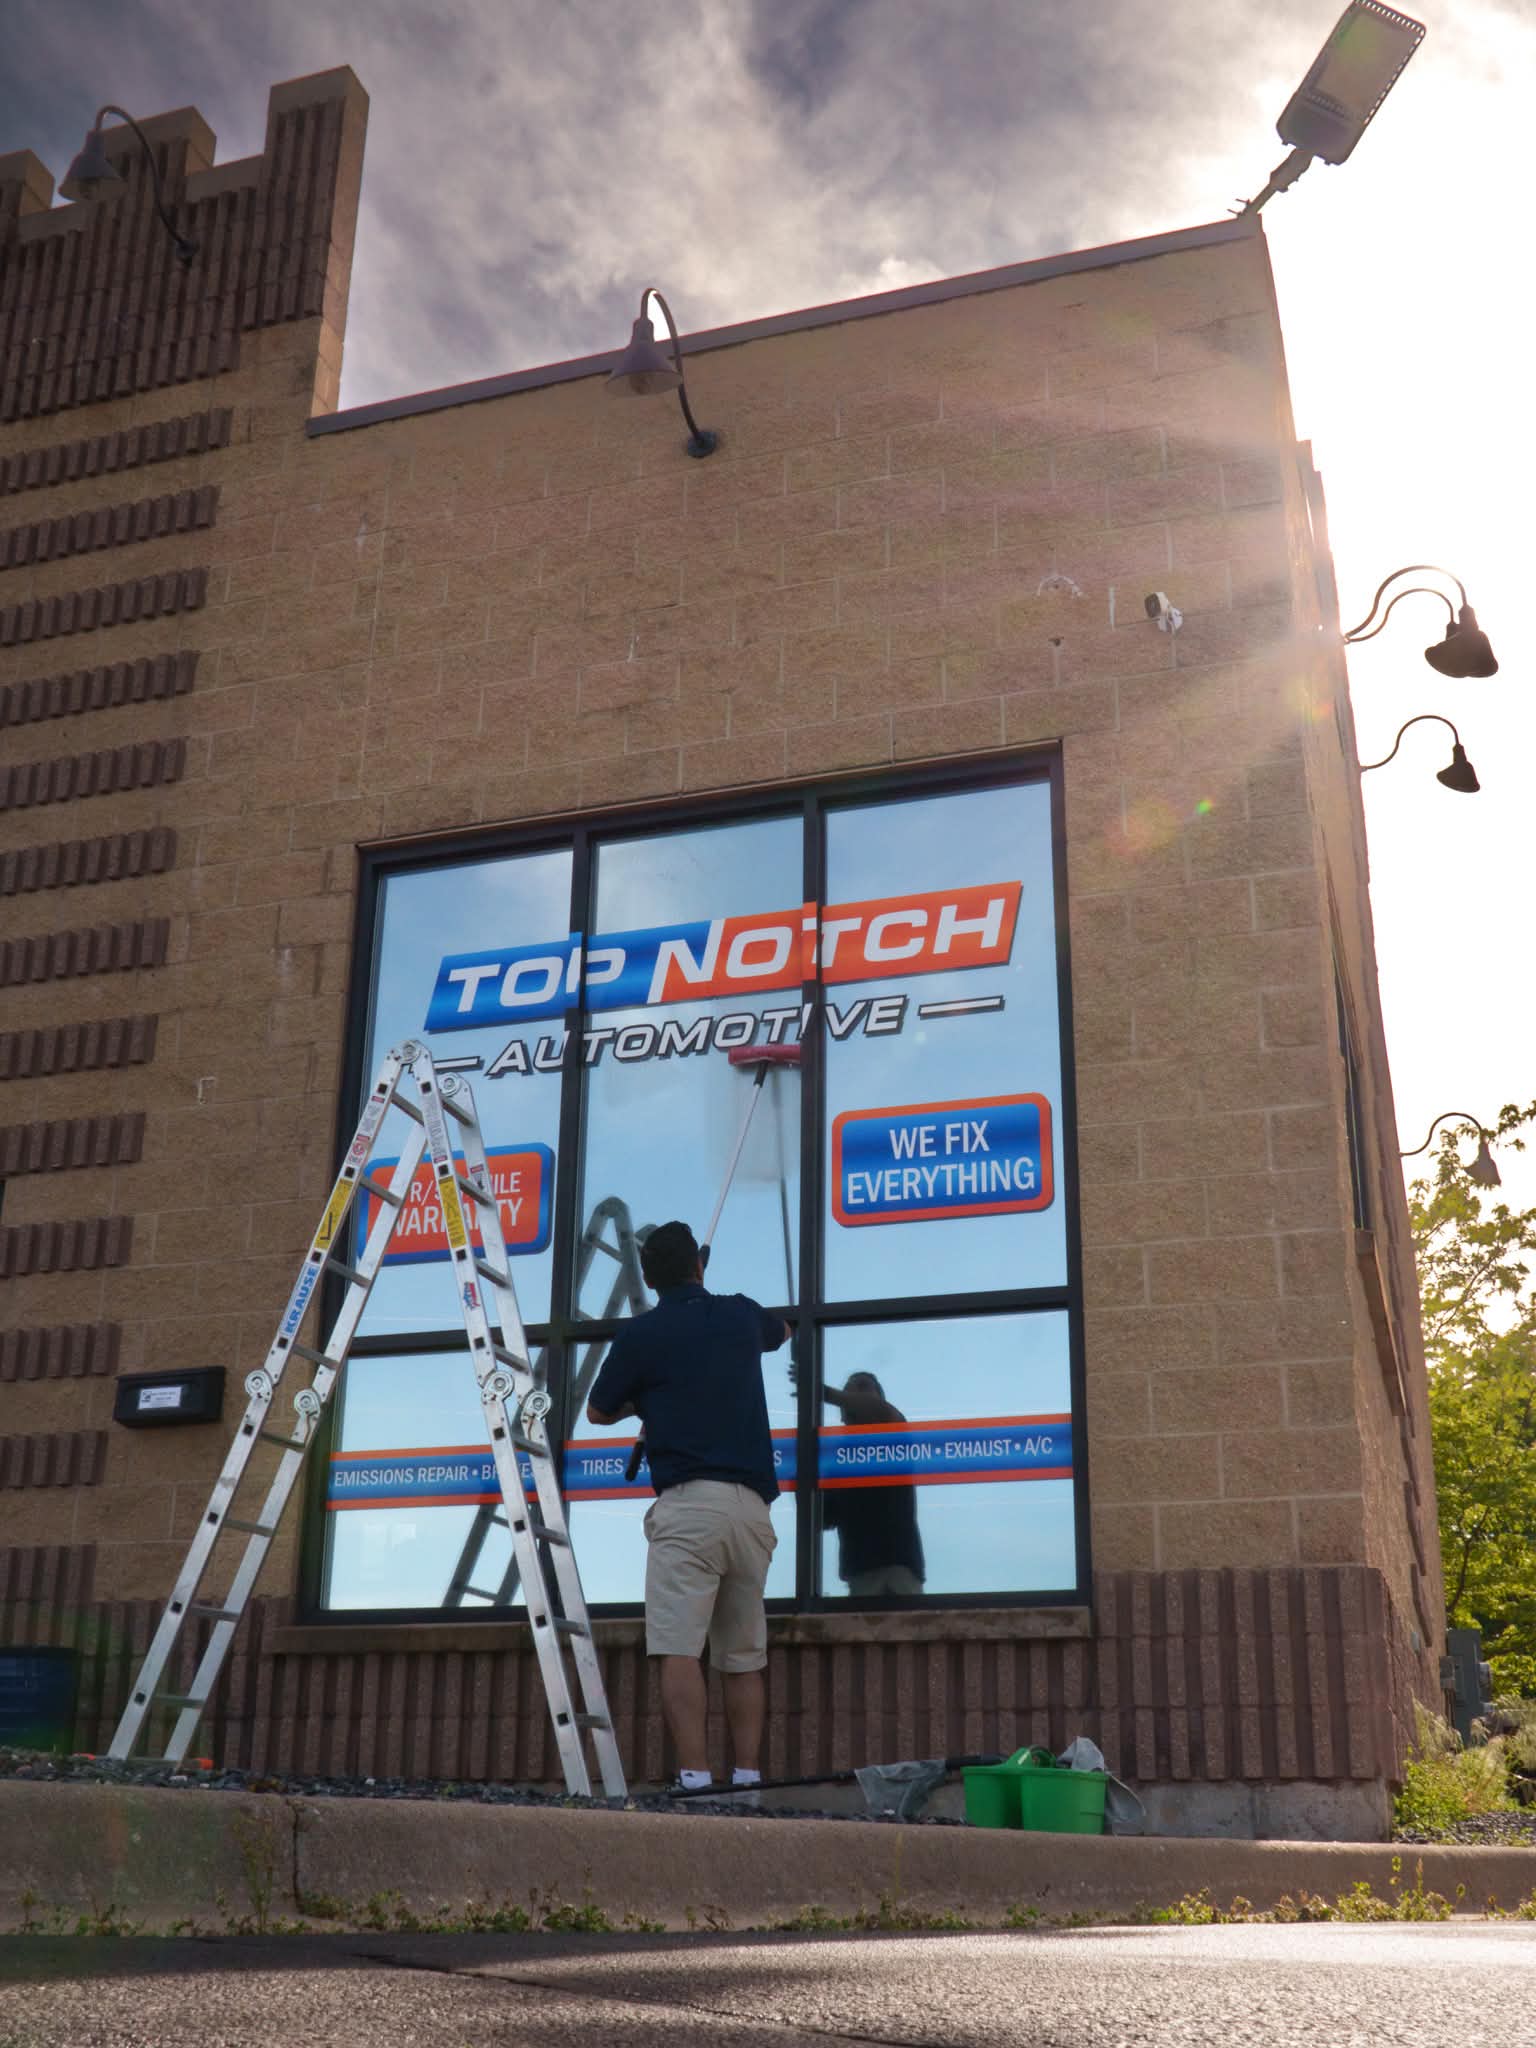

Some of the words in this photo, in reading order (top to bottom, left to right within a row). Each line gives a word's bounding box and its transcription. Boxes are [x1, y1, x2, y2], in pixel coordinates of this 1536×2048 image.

[447, 946, 627, 1014] TOP
[646, 897, 1006, 1005] NOTCH
[485, 994, 908, 1079] AUTOMOTIVE
[888, 1125, 937, 1160] WE
[945, 1120, 990, 1156] FIX
[490, 1171, 522, 1195] ILE
[847, 1156, 1035, 1205] EVERYTHING
[284, 1267, 318, 1334] KRAUSE
[581, 1458, 624, 1476] TIRES
[836, 1443, 932, 1465] SUSPENSION
[944, 1439, 1012, 1460] EXHAUST
[1023, 1436, 1053, 1457] A/C
[335, 1467, 414, 1488] EMISSIONS
[417, 1464, 468, 1483] REPAIR
